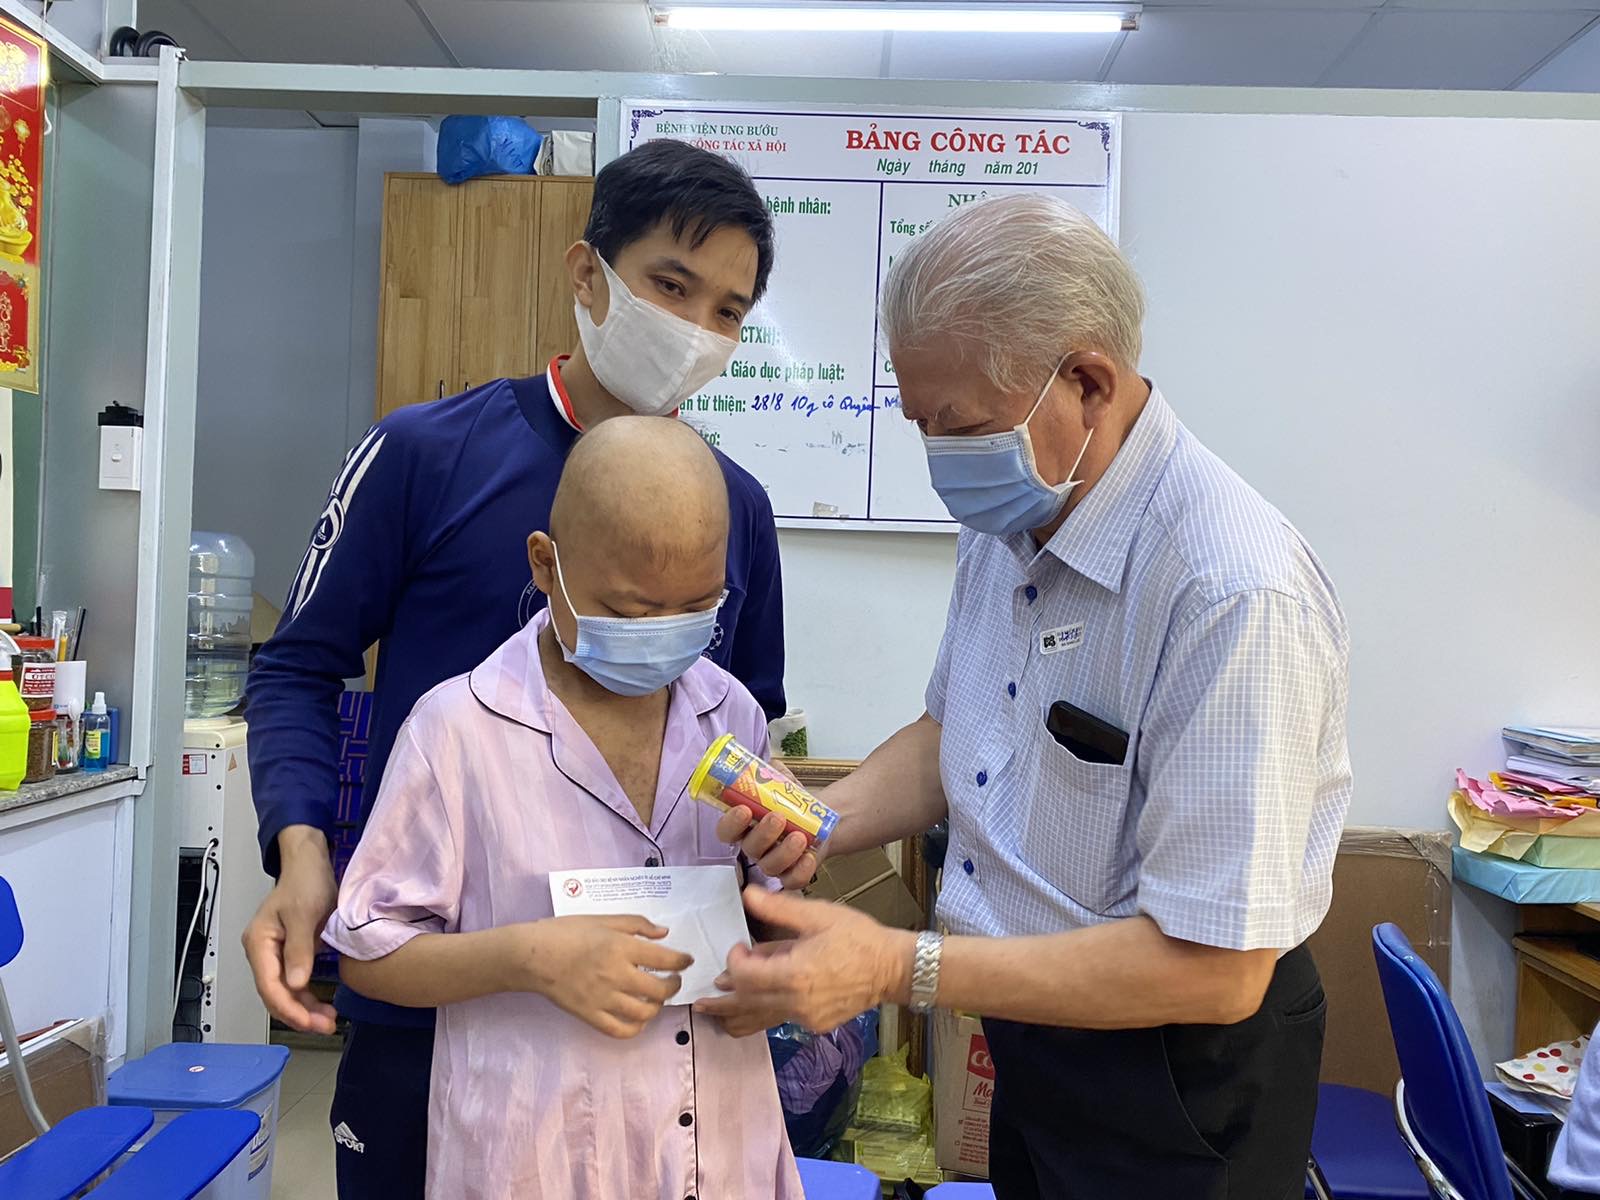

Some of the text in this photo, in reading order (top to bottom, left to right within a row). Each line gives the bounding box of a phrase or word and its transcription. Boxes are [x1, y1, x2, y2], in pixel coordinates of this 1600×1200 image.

[656, 122, 779, 137] BỆNH VIỆN UNG BƯỚU
[846, 122, 1071, 155] BẢNG CÔNG TÁC
[723, 138, 745, 151] TÁC
[747, 139, 762, 152] XÃ
[766, 139, 787, 154] HỘI
[877, 158, 1039, 177] Ngày tháng năm 201
[766, 195, 832, 217] bệnh nhân:
[890, 218, 917, 237] Tổng
[731, 360, 756, 379] Giáo
[760, 361, 781, 381] dục
[784, 362, 814, 384] pháp
[818, 363, 845, 385] luật:
[697, 394, 711, 411] từ
[713, 395, 746, 416] thiện:
